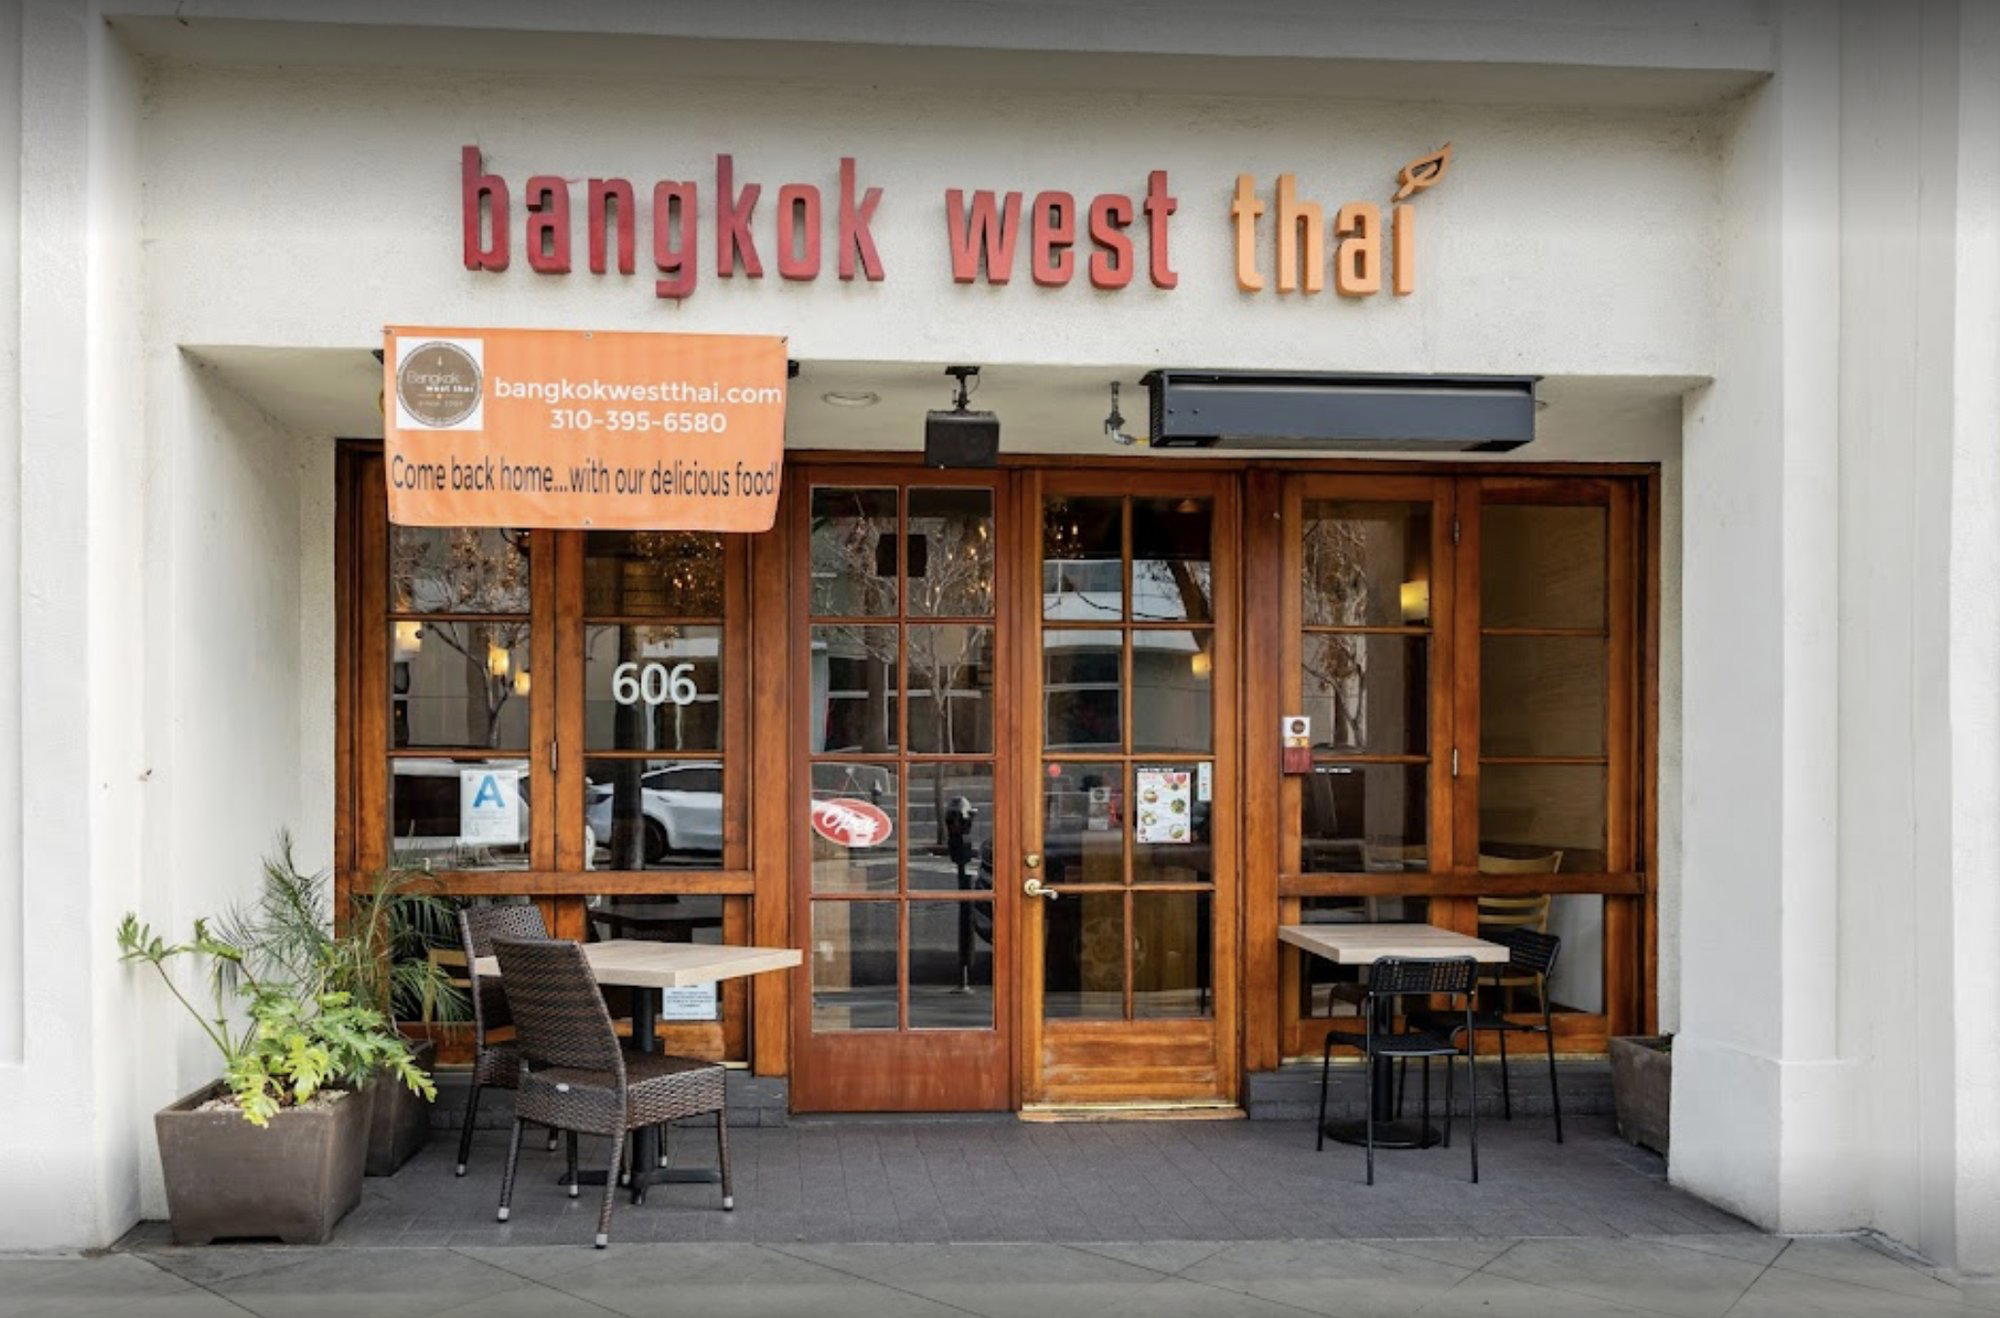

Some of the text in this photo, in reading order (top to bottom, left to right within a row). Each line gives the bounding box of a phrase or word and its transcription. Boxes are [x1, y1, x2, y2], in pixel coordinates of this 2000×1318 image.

[462, 142, 1453, 300] bangkok west thai
[494, 376, 783, 404] bangkokwestthai.com
[550, 408, 728, 433] 310-395-6580
[392, 454, 447, 491] Come
[451, 454, 495, 491] back
[614, 467, 646, 493] our
[650, 459, 730, 496] delicious
[613, 662, 697, 706] 606
[472, 774, 506, 808] A
